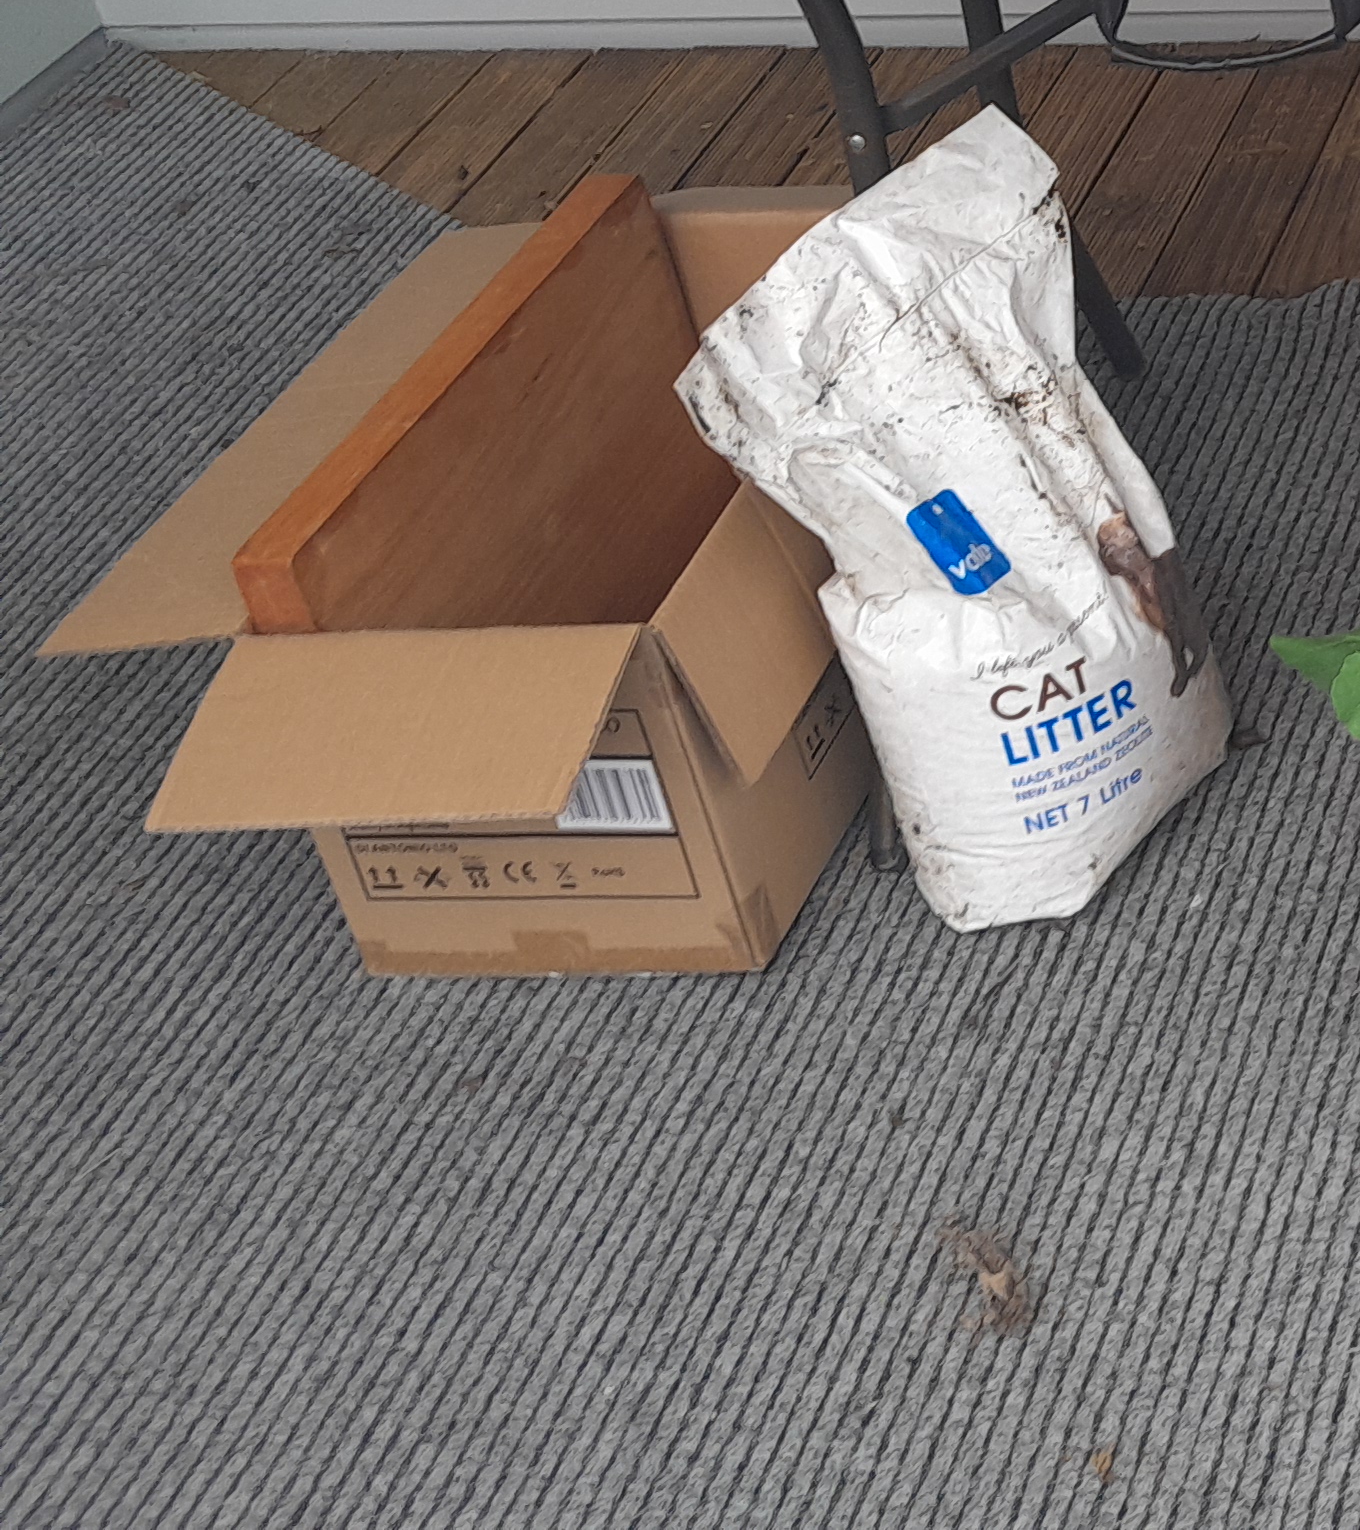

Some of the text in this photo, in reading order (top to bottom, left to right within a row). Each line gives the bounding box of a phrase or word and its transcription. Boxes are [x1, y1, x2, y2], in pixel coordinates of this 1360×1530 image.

[989, 655, 1088, 721] CAT
[1000, 677, 1137, 767] LITTER
[1010, 714, 1151, 789] MADE FROM NATURAL
[1014, 785, 1048, 804] NEW
[1051, 756, 1113, 793] ZEALAND
[1023, 767, 1144, 835] NET 7 Litre
